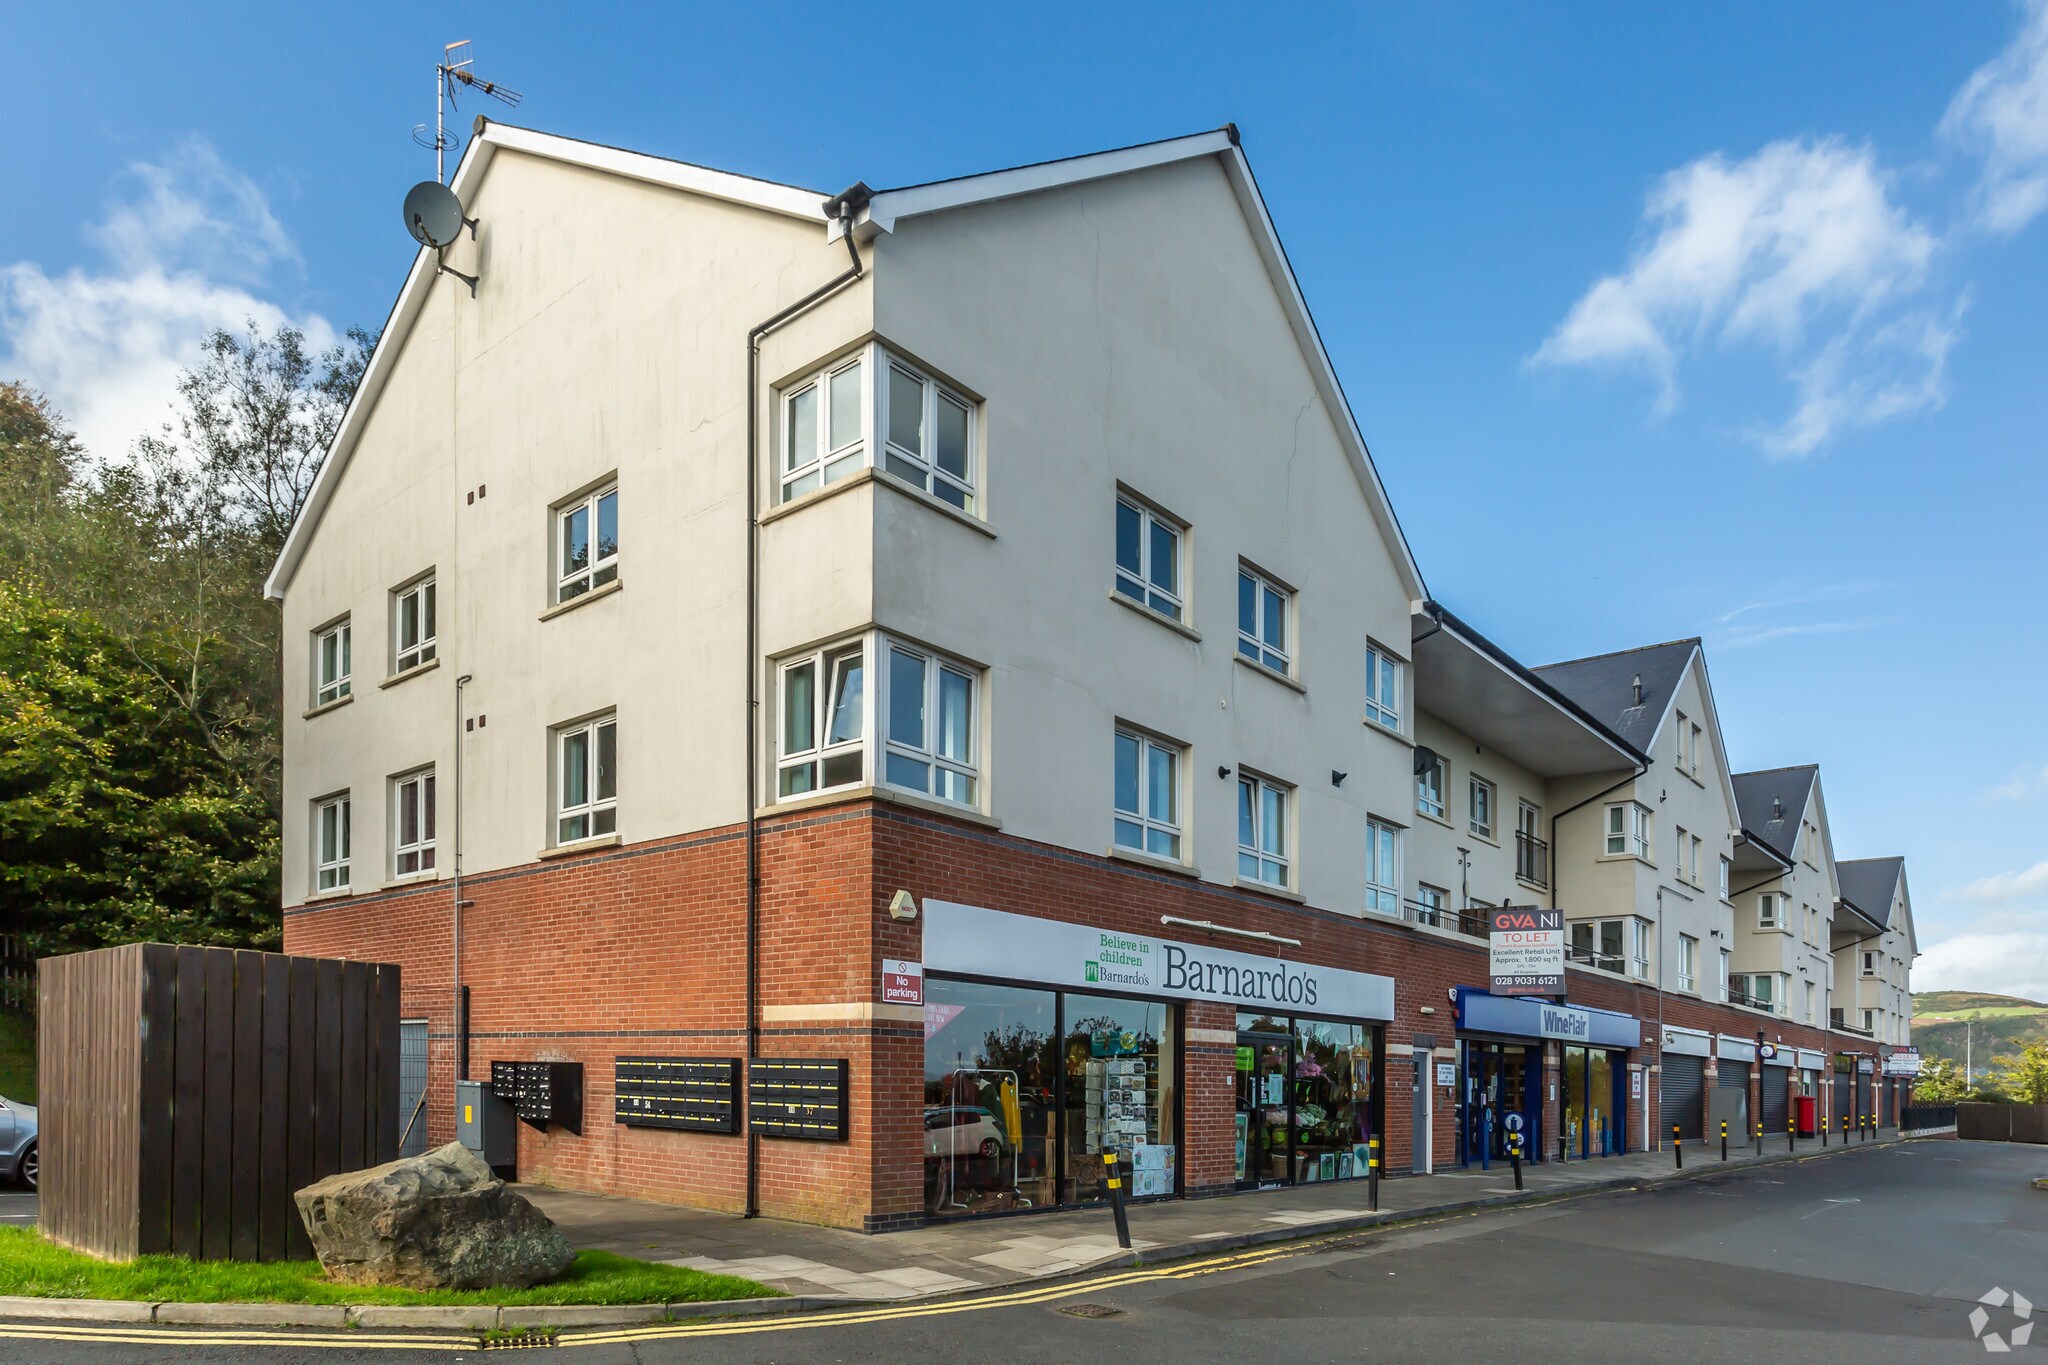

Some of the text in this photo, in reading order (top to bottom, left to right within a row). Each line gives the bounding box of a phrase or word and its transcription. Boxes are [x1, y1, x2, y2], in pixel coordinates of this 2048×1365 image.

[1495, 913, 1558, 929] GVA NI
[1099, 933, 1150, 954] Believe in
[1503, 932, 1550, 943] TO LET
[1099, 950, 1143, 967] children
[896, 975, 909, 986] No
[1099, 966, 1150, 987] Barnardo's
[1162, 944, 1318, 1006] Barnardo's
[1495, 976, 1558, 985] 028 9031 6121
[887, 987, 918, 1001] parking
[1543, 1010, 1586, 1036] WineFlair
